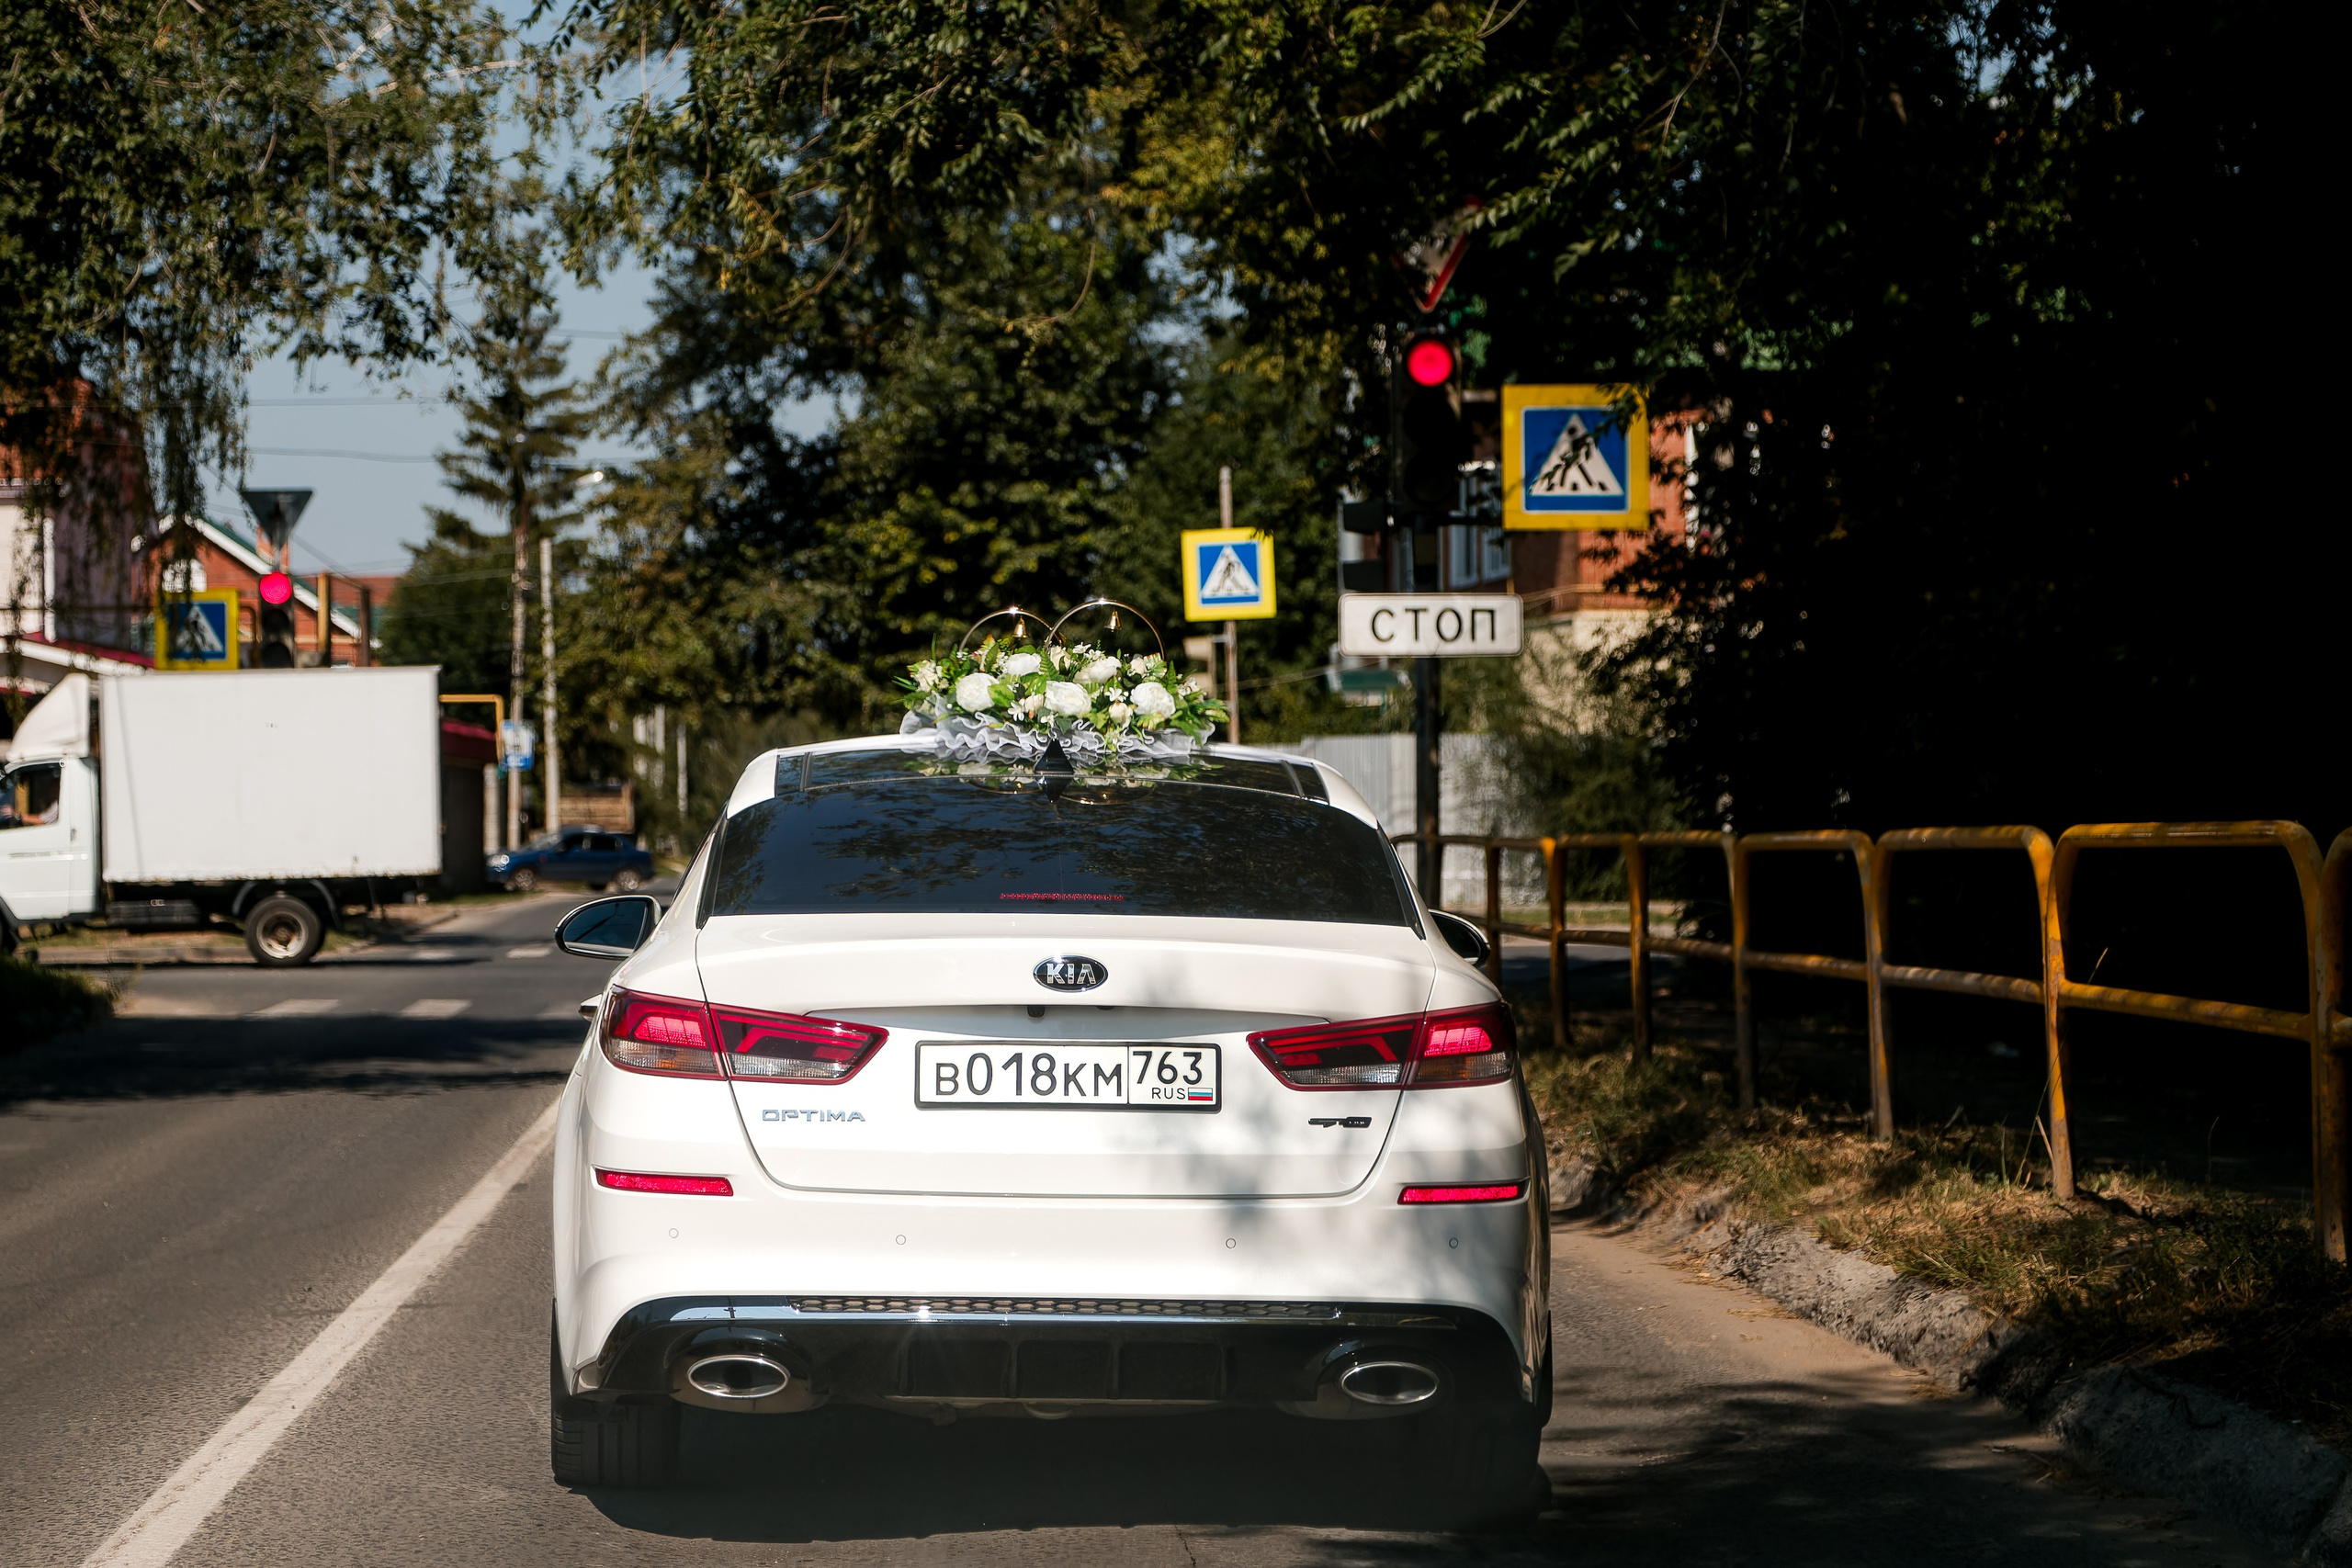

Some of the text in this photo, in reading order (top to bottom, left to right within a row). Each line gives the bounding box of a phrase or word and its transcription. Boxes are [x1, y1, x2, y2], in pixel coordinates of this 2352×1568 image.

[1371, 607, 1496, 643] СТОП
[1046, 963, 1097, 984] KIA
[935, 1050, 1203, 1097] В018КМ 763
[1151, 1087, 1186, 1100] RUS
[762, 1109, 866, 1122] OPTIMA
